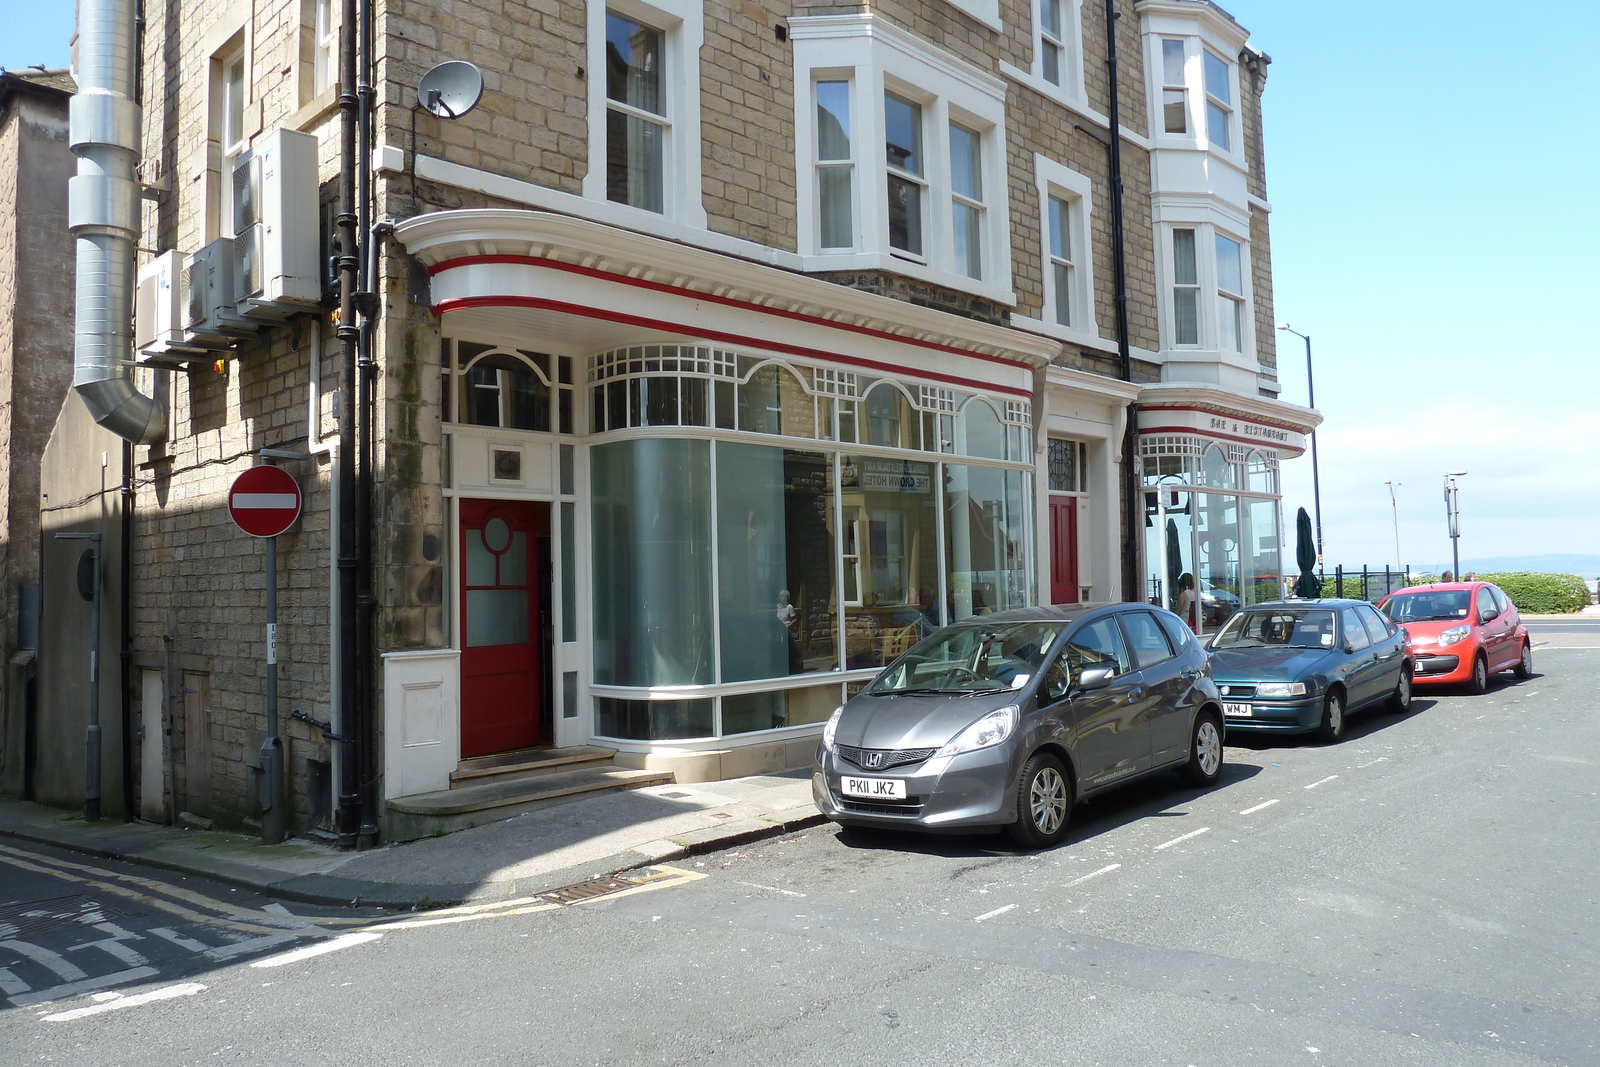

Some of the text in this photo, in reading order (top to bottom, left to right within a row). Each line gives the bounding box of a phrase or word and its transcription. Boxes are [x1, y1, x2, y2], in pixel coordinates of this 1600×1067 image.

[1210, 418, 1226, 430] BAR
[1244, 424, 1288, 441] RESTAURANT
[849, 779, 895, 795] PK11 JKZ
